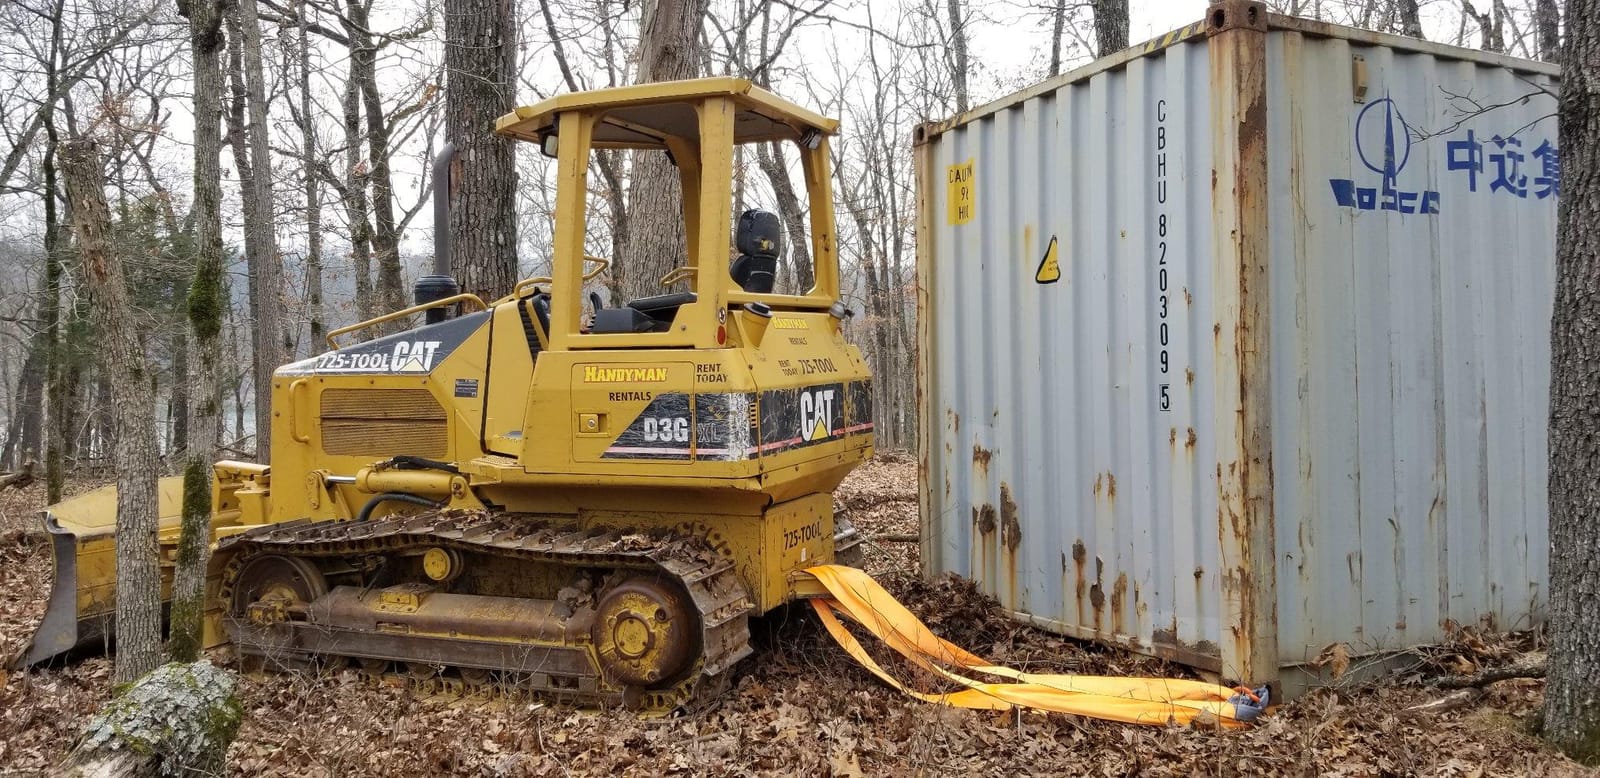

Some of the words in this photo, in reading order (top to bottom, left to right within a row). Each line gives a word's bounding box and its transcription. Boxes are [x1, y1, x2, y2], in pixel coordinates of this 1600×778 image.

[1158, 99, 1166, 203] CBHU
[1159, 214, 1168, 374] 820309
[319, 353, 389, 369] 725-TOOL
[390, 341, 442, 372] CAT
[697, 364, 721, 373] RENT
[778, 360, 791, 368] RENT
[798, 357, 837, 375] 725-TOOL
[584, 366, 668, 383] HANDYMAN
[697, 374, 728, 383] TODAY
[609, 391, 652, 402] RENTALS
[1161, 385, 1170, 410] 5
[800, 390, 834, 442] CAT
[644, 417, 689, 443] D3G
[697, 422, 721, 443] XL
[784, 521, 821, 551] 725-TOOL
